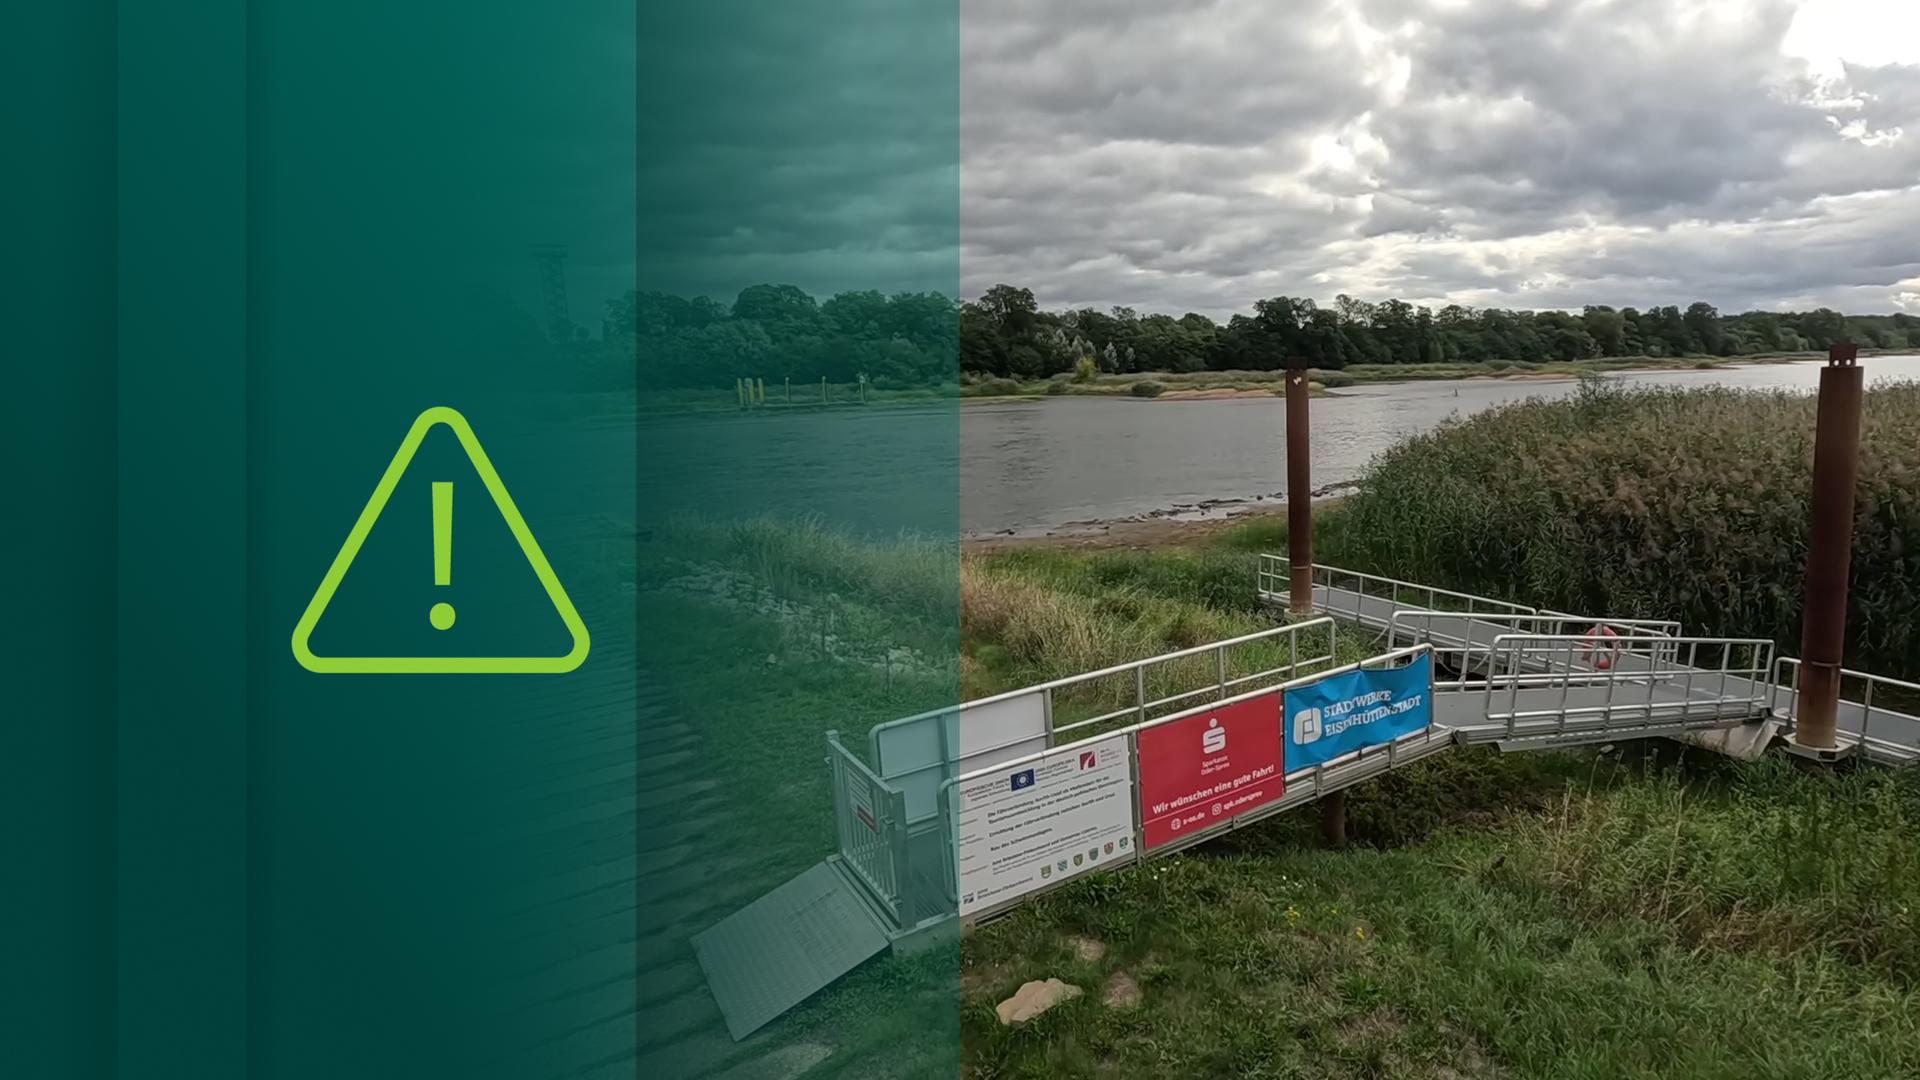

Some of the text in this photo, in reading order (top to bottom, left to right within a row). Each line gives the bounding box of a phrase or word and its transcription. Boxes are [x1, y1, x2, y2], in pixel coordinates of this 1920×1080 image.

[1325, 694, 1422, 737] EISENHÜTTENSTADT
[1201, 762, 1230, 776] Oder-Spree
[1202, 755, 1228, 769] Sparkasse
[1152, 764, 1275, 815] Wir wünschen eine gute Fahrt!
